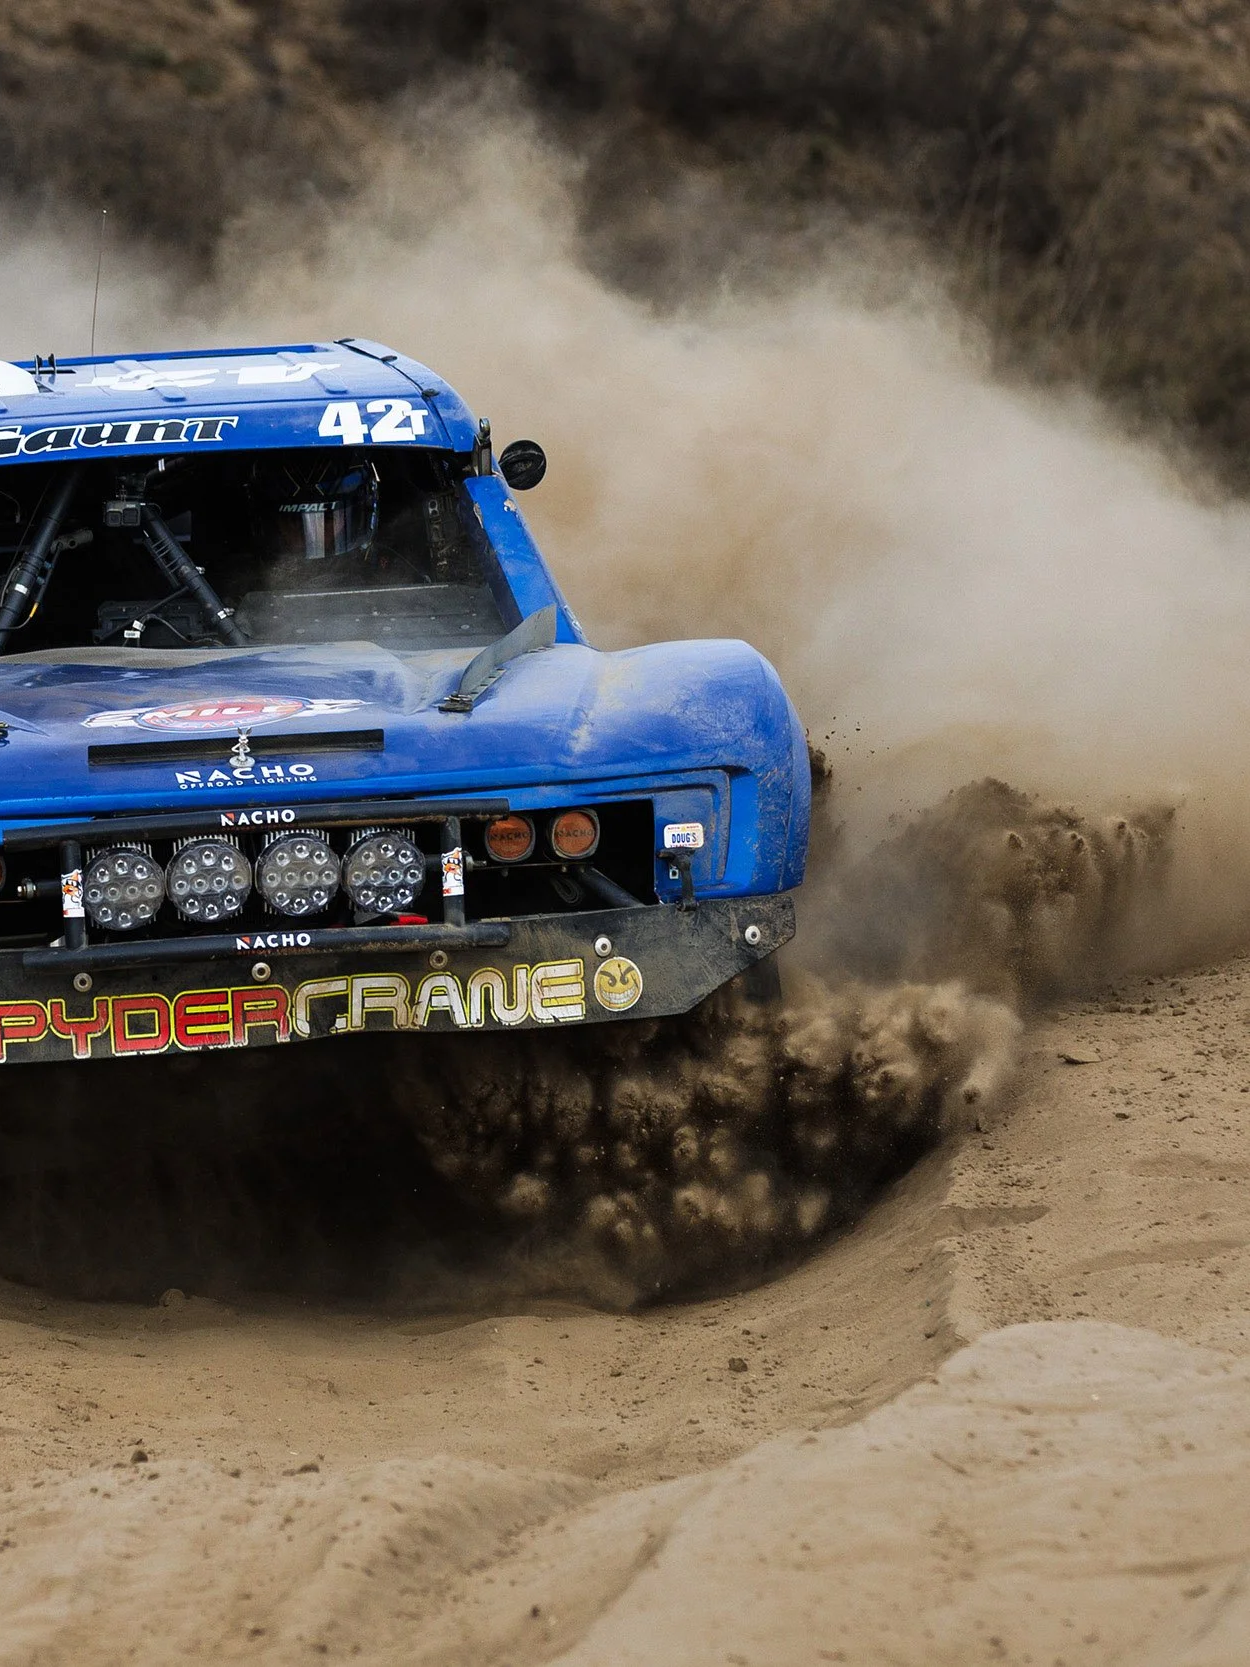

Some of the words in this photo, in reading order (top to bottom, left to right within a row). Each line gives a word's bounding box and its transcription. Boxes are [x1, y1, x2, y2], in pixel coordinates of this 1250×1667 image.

[279, 501, 339, 512] IMPACT
[175, 763, 314, 783] NACHO
[179, 780, 244, 790] OFFROAD
[254, 775, 317, 785] LIGHTING
[220, 809, 296, 827] NACHO
[235, 933, 311, 950] NACHO
